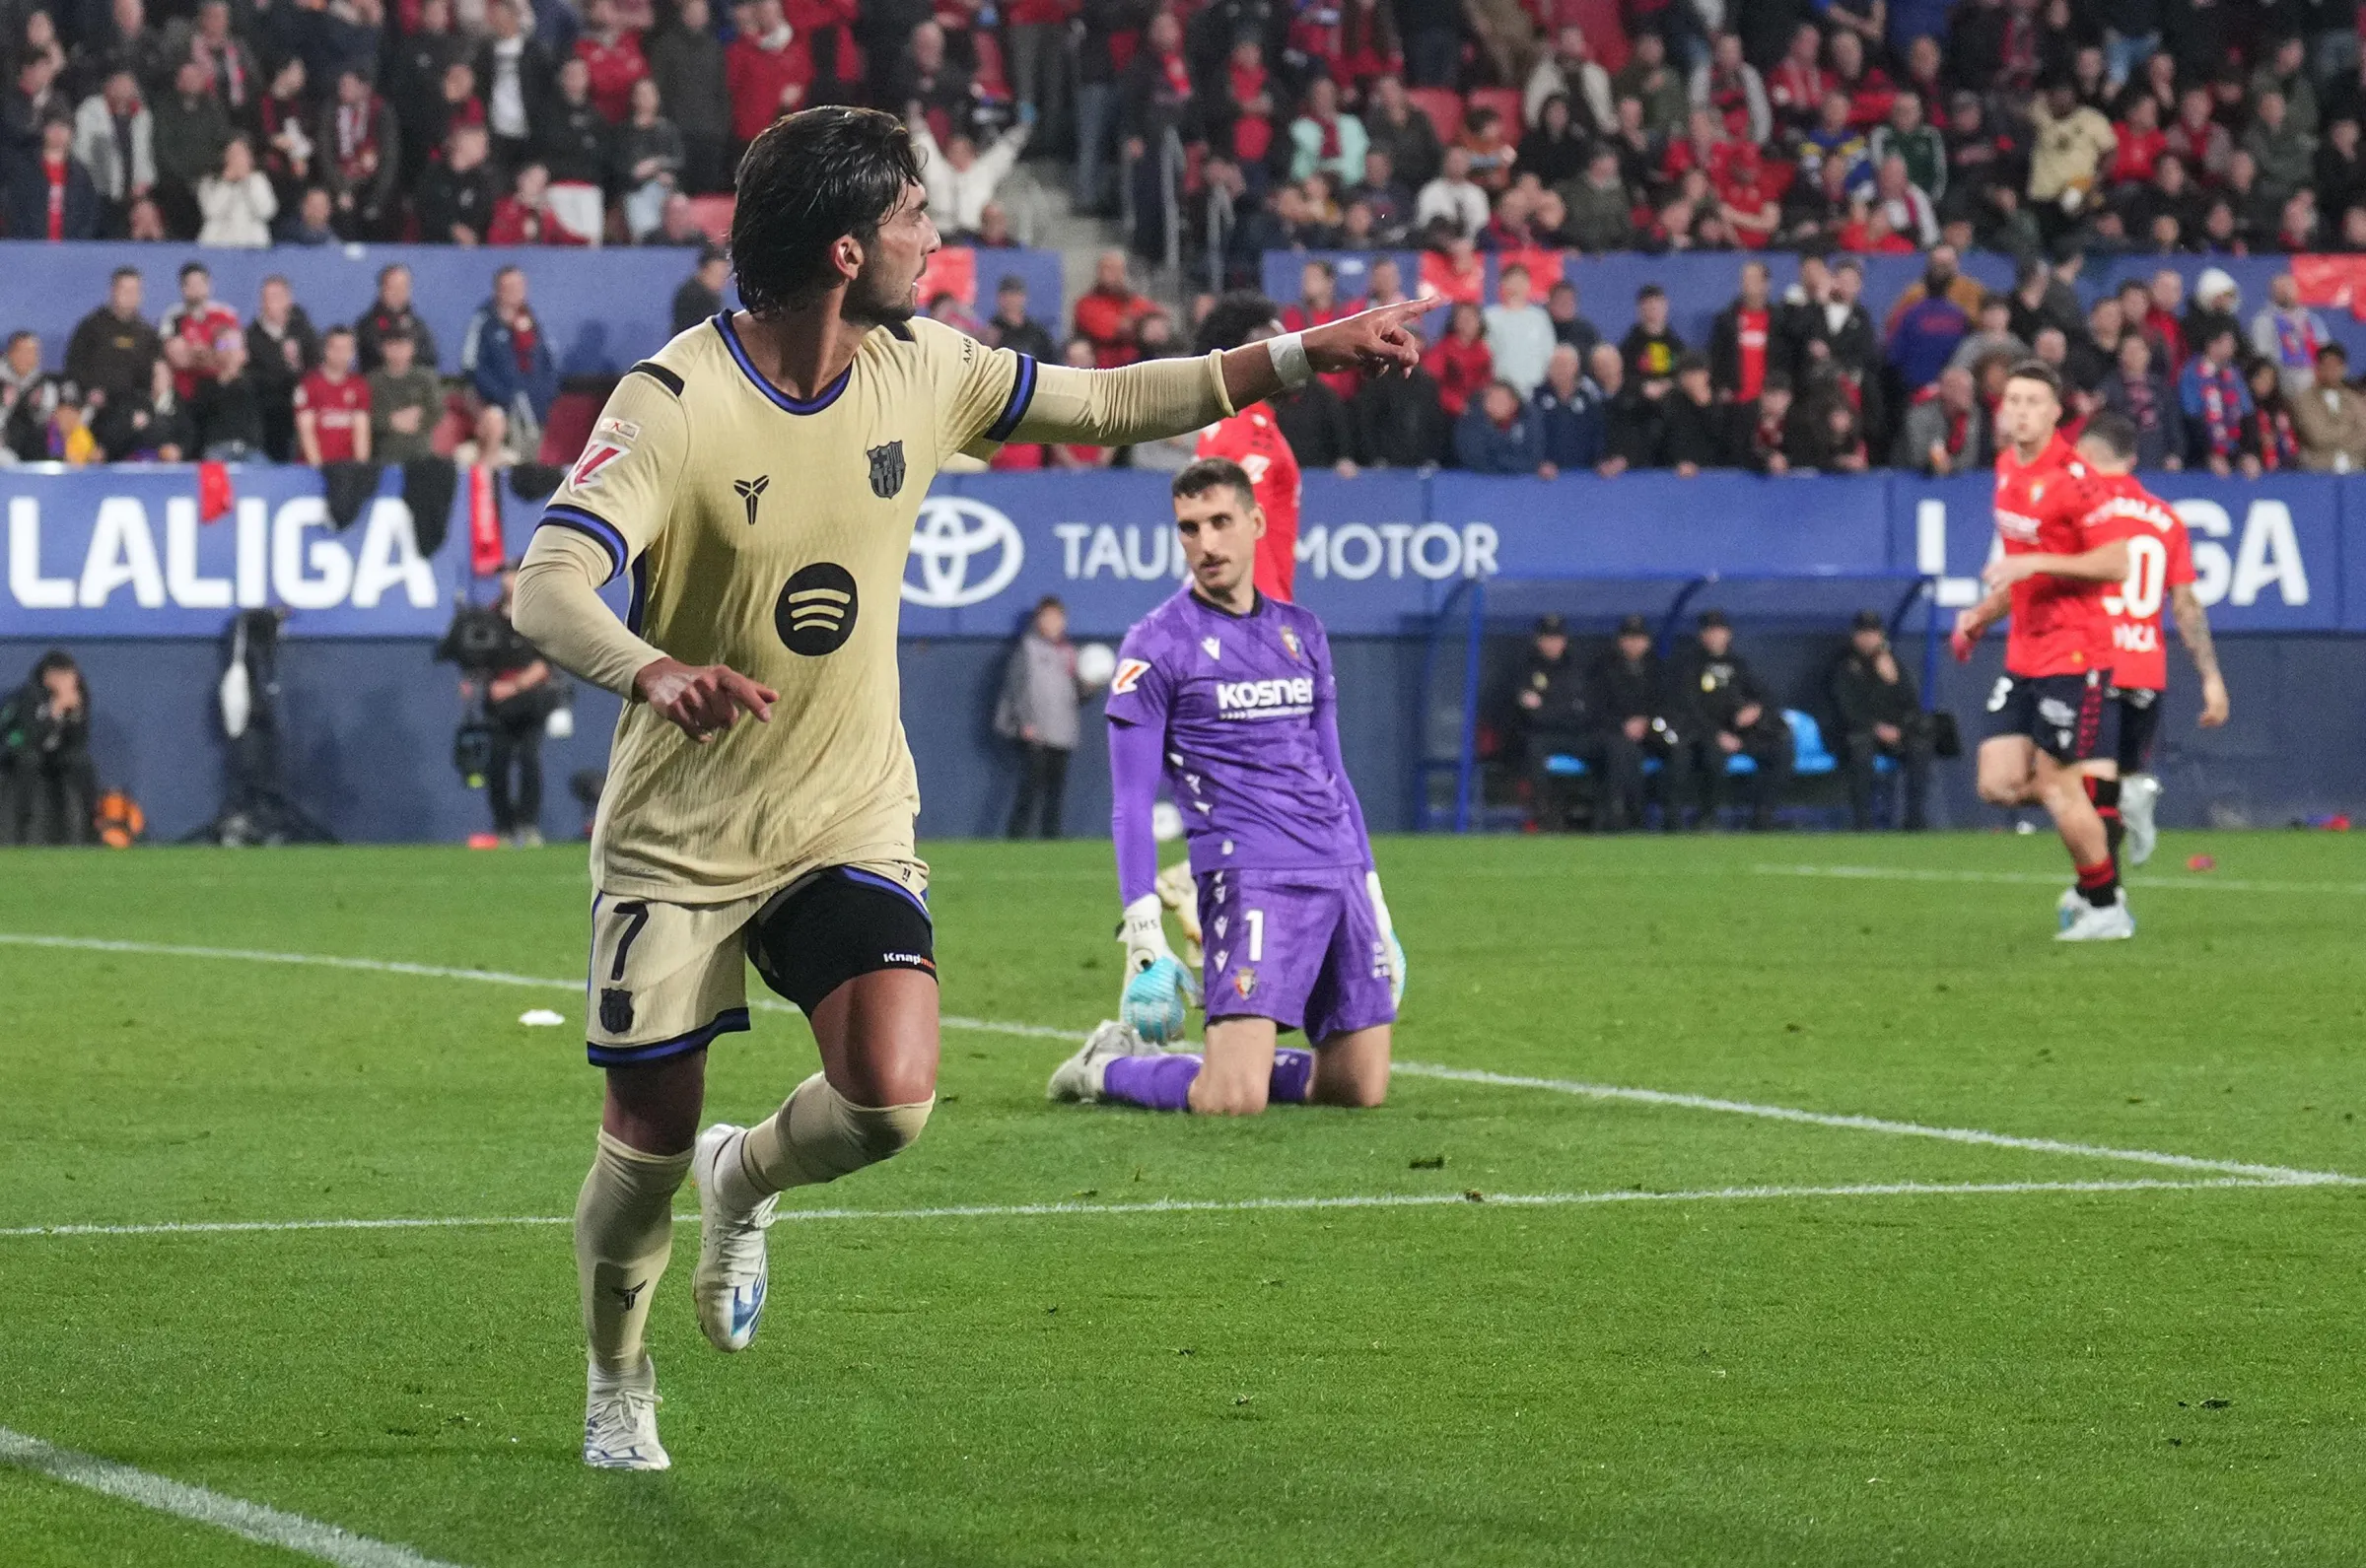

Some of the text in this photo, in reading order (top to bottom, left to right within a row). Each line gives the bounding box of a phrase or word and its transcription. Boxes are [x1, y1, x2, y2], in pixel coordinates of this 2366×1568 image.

[8, 496, 439, 609] LALIGA
[1293, 522, 1499, 580] MOTOR
[610, 901, 650, 982] 7
[1244, 909, 1264, 962] 1
